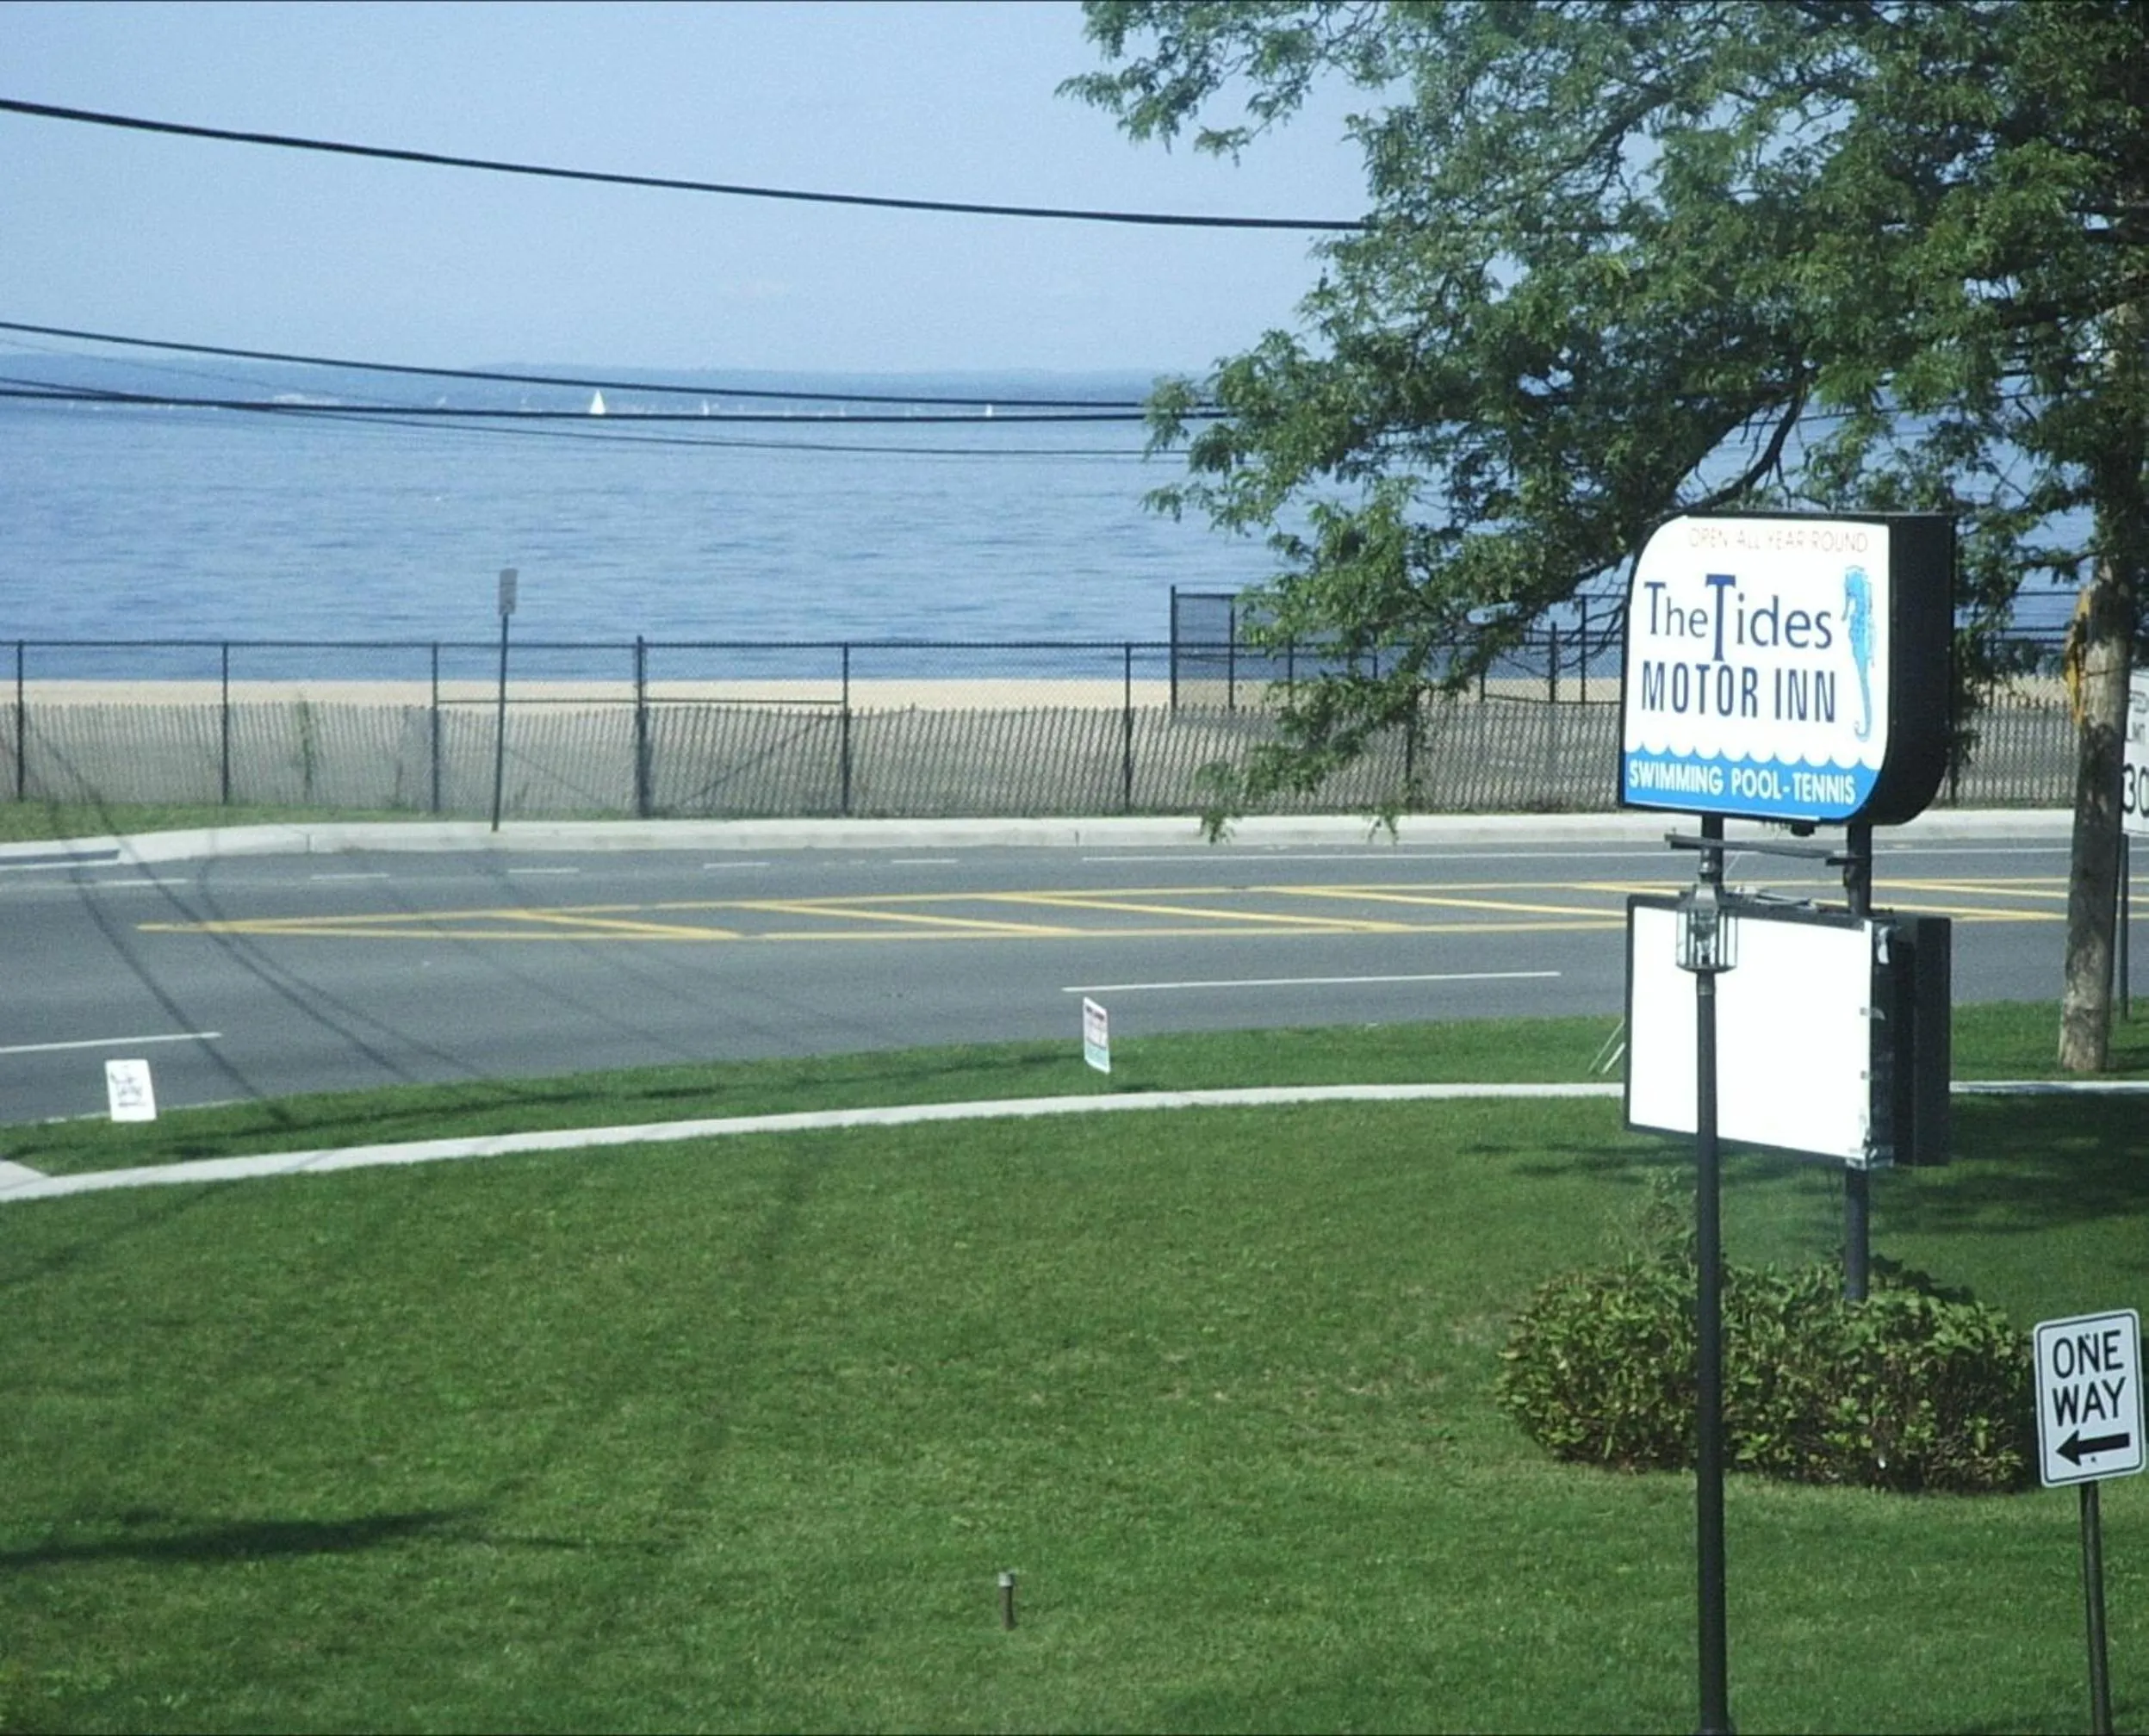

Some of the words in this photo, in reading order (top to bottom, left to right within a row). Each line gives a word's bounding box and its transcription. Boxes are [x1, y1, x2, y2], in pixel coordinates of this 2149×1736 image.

[1689, 527, 1728, 549] OPEN
[1736, 530, 1761, 550] ALL
[1768, 530, 1804, 551] YEAR
[1811, 530, 1868, 553] ROUND
[1643, 581, 1708, 638] The
[1705, 574, 1833, 661] Tides
[1642, 660, 1758, 717] MOTOR
[1774, 667, 1835, 722] INN
[1629, 760, 1724, 796] SWIMMING
[2053, 1330, 2124, 1380] ONE
[2052, 1376, 2126, 1427] WAY
